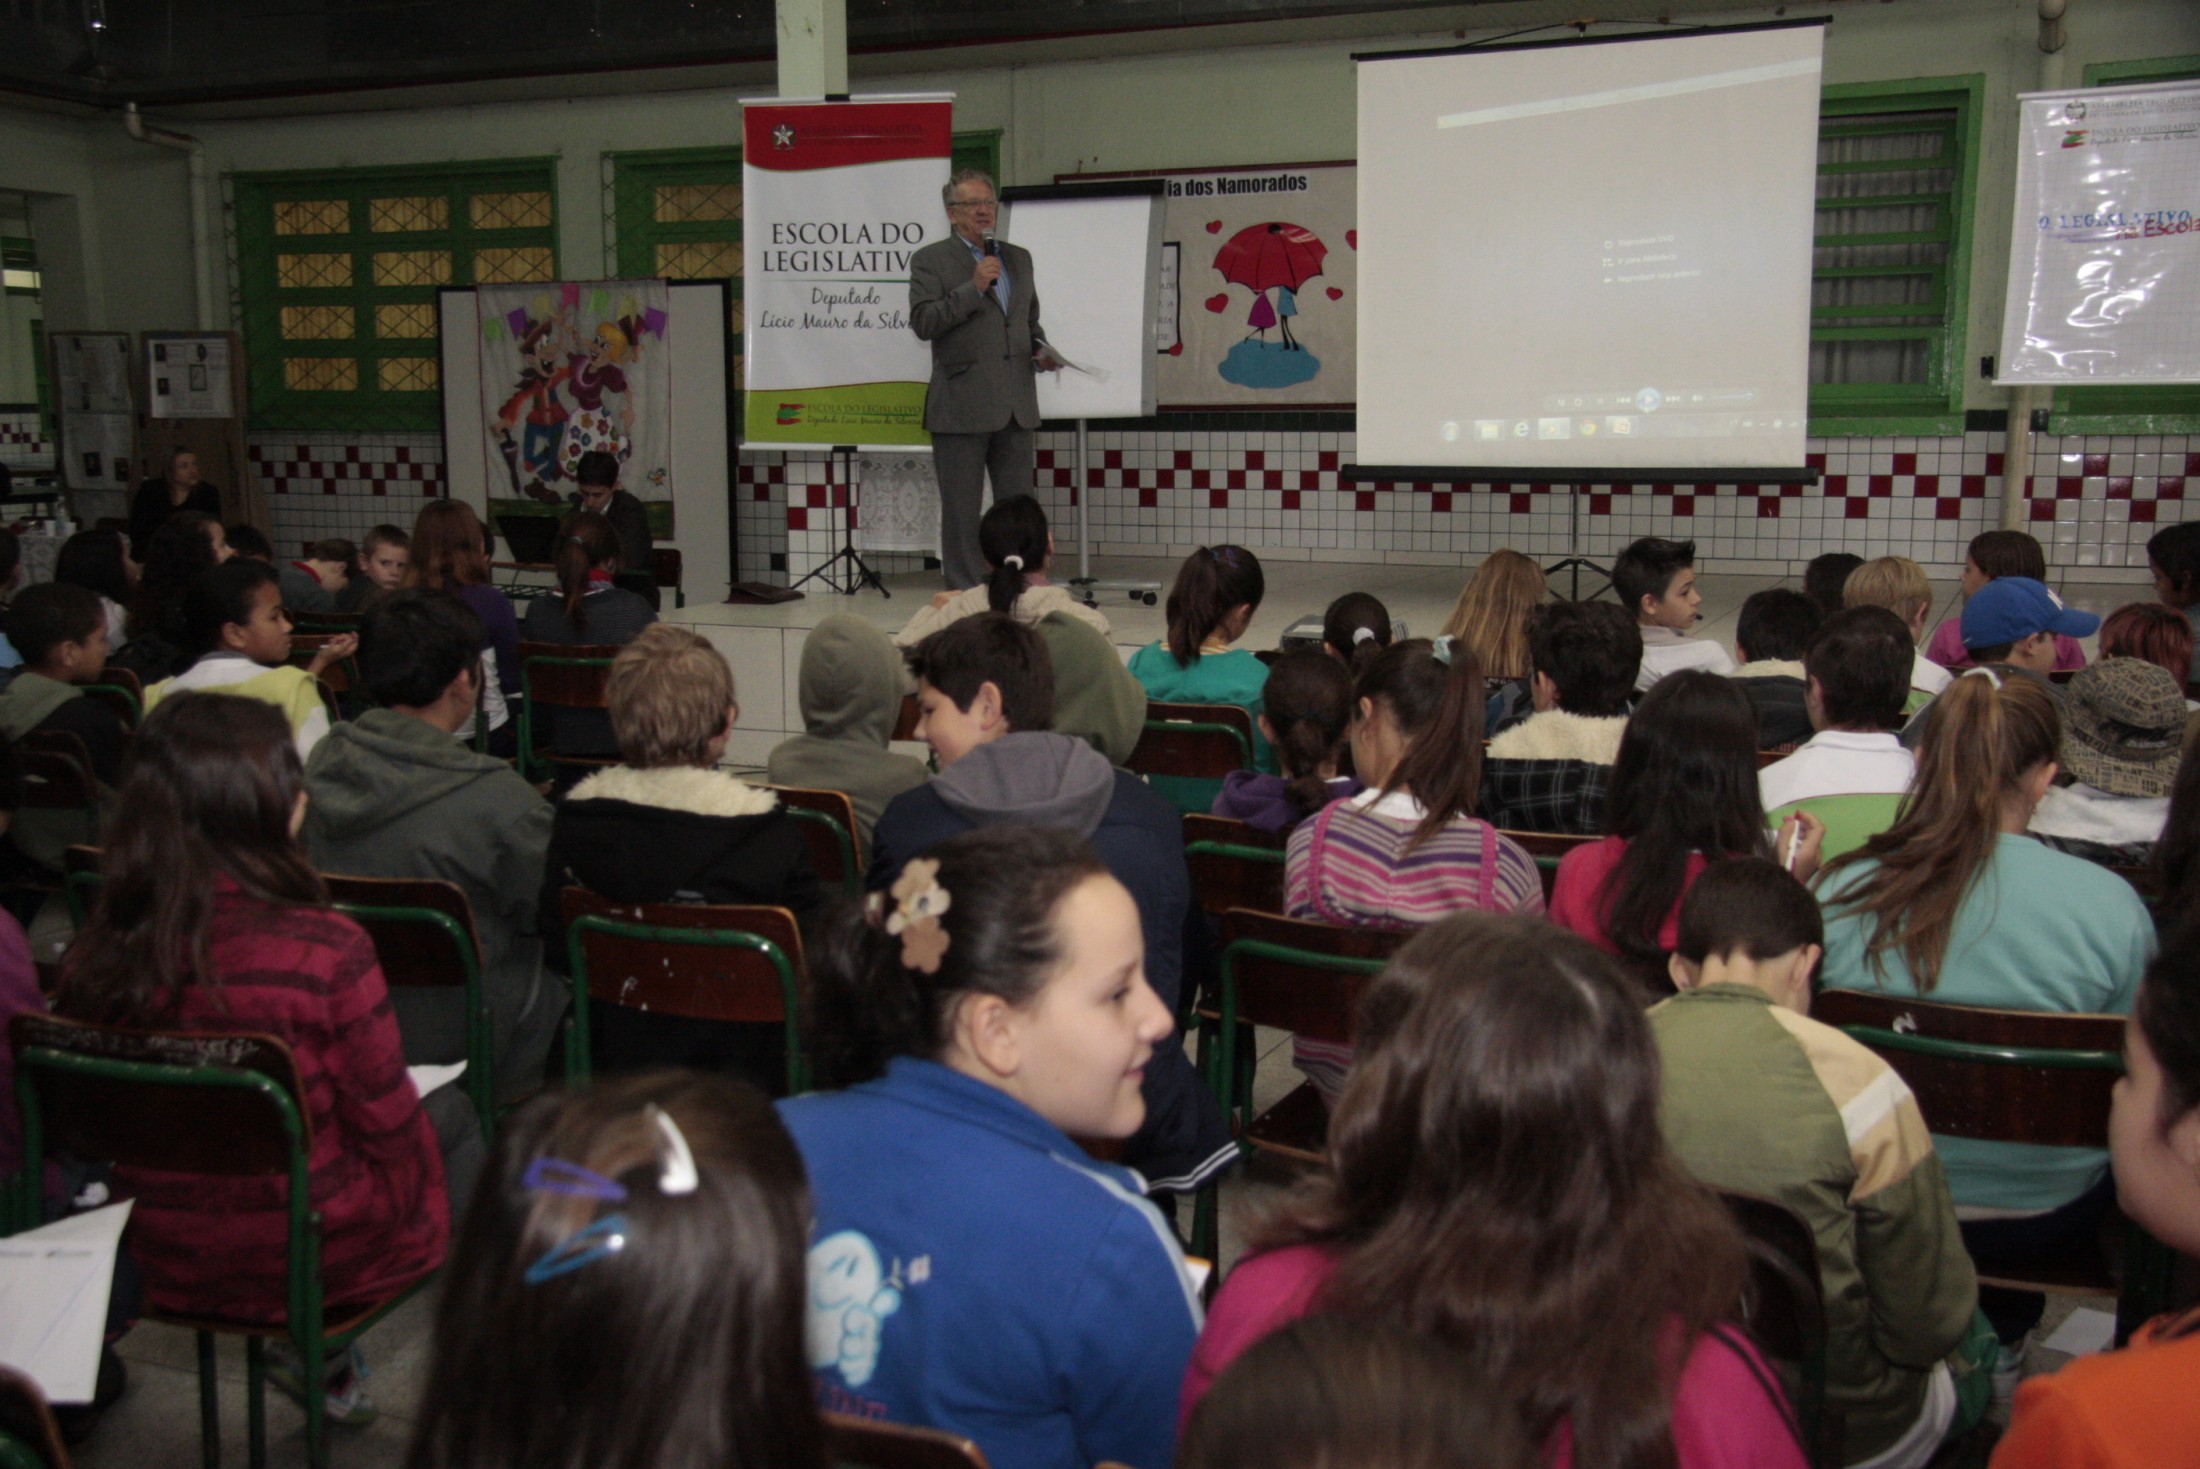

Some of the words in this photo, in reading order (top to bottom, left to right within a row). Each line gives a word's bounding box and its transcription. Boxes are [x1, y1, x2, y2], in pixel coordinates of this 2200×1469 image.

[1166, 180, 1182, 197] ia
[1185, 178, 1213, 196] dos
[1217, 174, 1307, 195] Namorados
[2060, 209, 2191, 229] LEGISLATIVO
[772, 223, 873, 245] ESCOLA
[881, 222, 924, 245] DO
[763, 250, 911, 273] LEGISLATIV
[811, 286, 881, 314] Deputado
[760, 310, 795, 329] Lício
[799, 312, 849, 329] Mauro
[853, 310, 873, 329] da
[877, 309, 914, 330] Silve
[845, 404, 860, 413] DO
